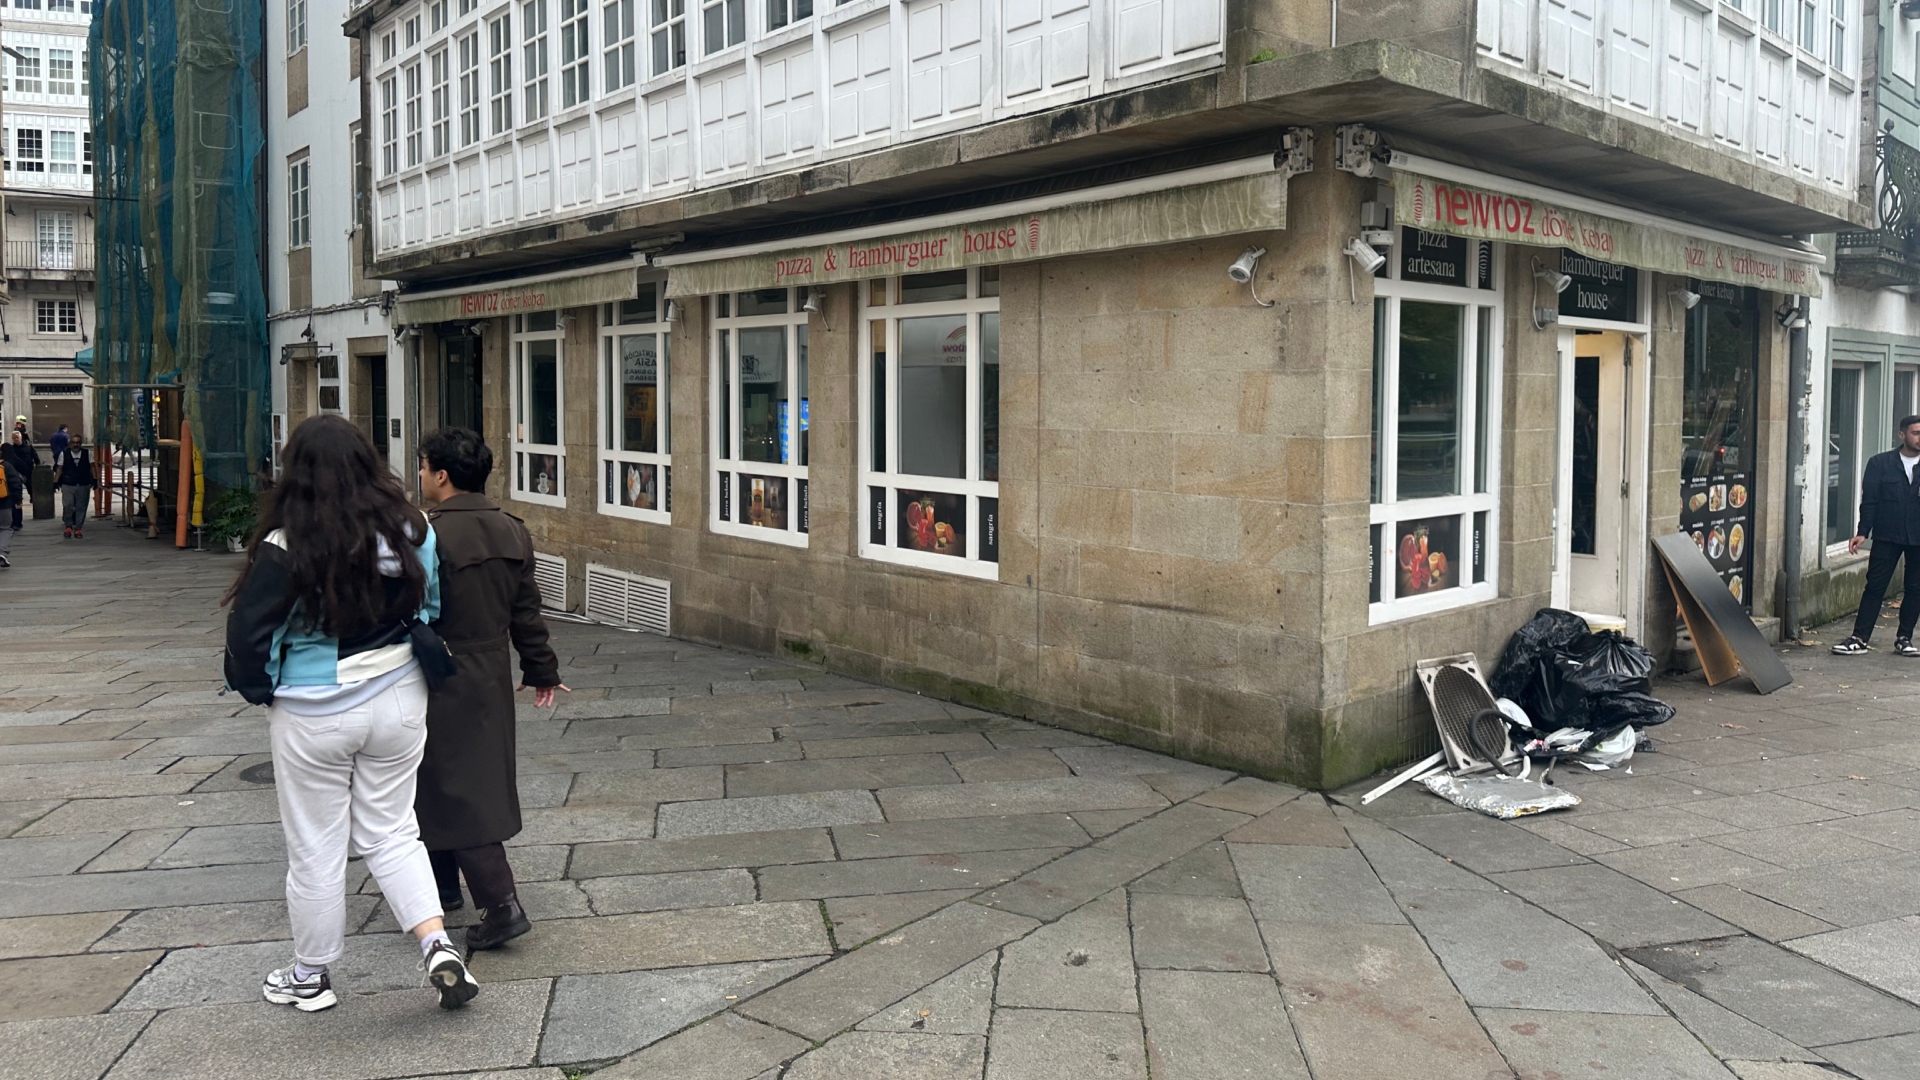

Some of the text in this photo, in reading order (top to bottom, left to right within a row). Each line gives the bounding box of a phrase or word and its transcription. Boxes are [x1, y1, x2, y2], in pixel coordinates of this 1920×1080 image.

[1434, 183, 1535, 235] newroz
[1541, 207, 1576, 242] döne
[1417, 230, 1448, 251] pizza
[776, 227, 1017, 282] pizza & hamburguer house
[1407, 256, 1456, 278] artesana
[1561, 248, 1625, 286] hamburguer
[460, 292, 499, 314] newroz
[1577, 283, 1608, 310] house
